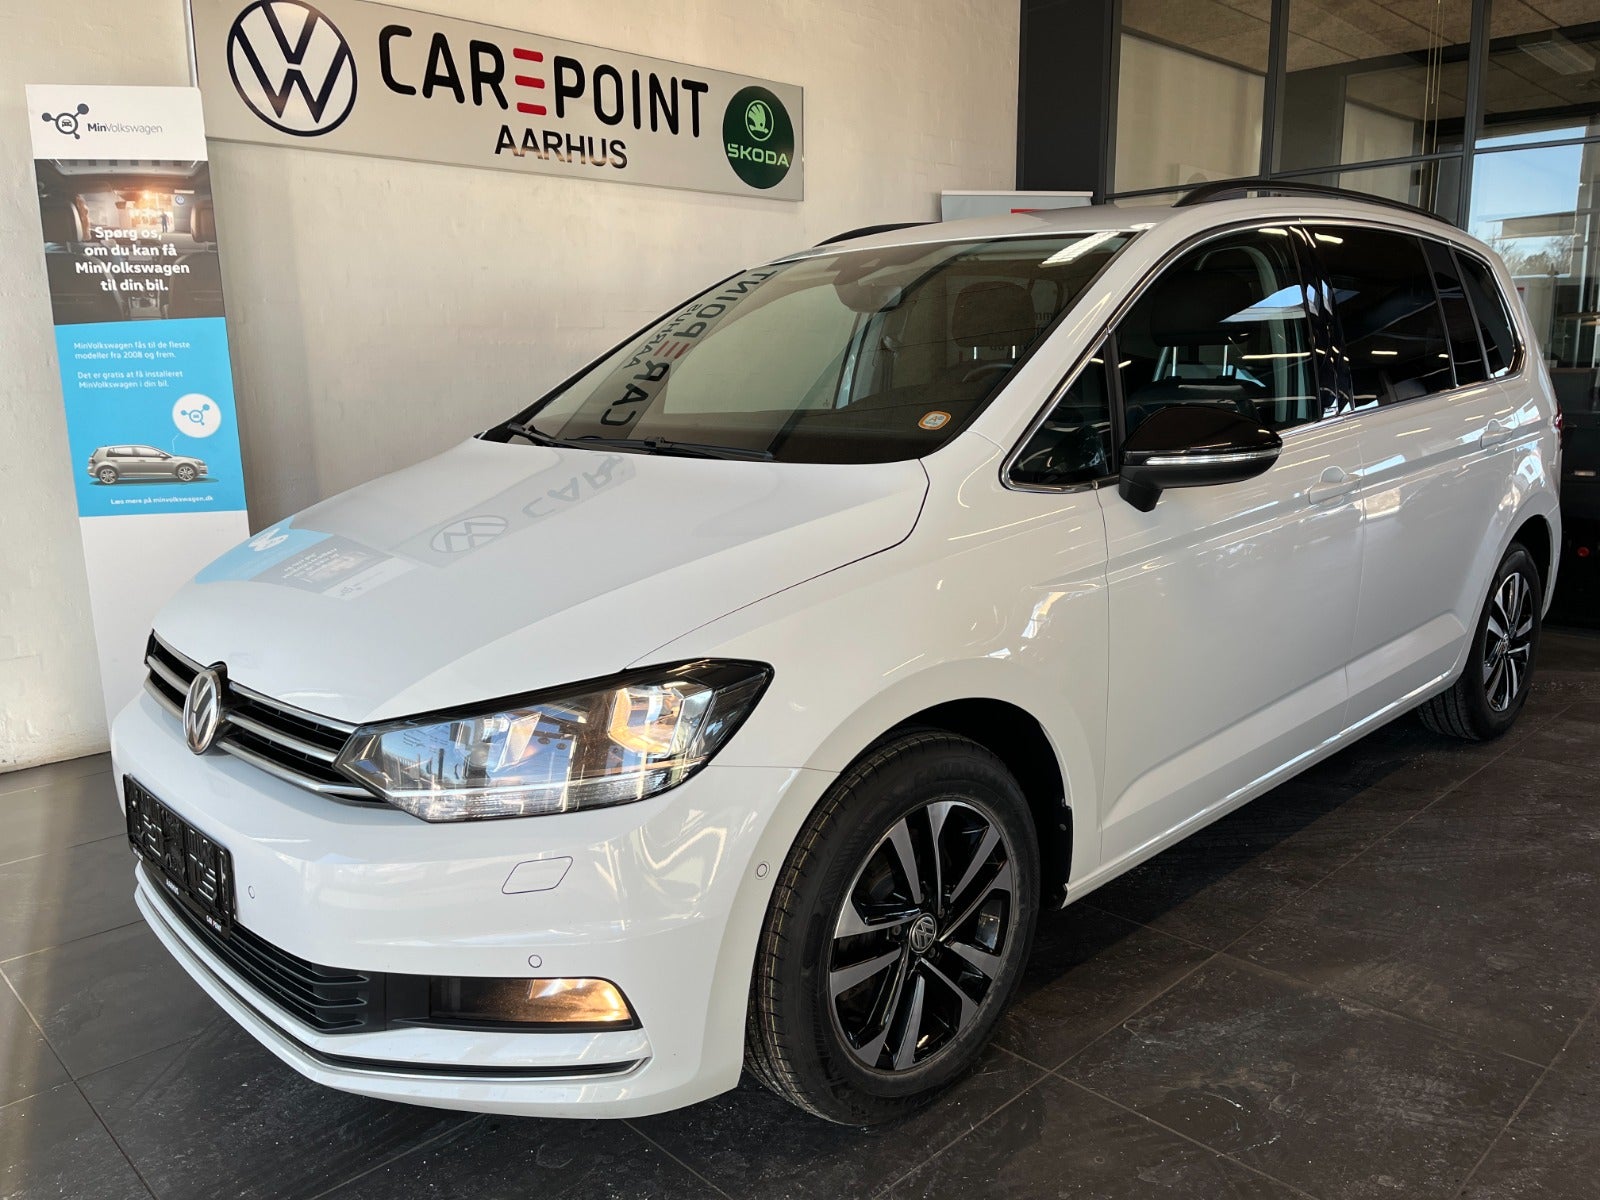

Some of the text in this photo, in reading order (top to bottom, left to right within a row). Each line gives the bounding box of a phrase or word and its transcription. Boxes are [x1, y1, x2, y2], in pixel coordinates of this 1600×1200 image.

[379, 24, 709, 138] CAREPOINT
[87, 122, 163, 134] MinVolkswagen
[494, 124, 629, 169] AARHUS
[95, 226, 162, 241] Spørg os,
[84, 243, 177, 256] om du kan få
[75, 261, 190, 276] MinVolkswagen
[100, 279, 169, 291] til din bil.
[74, 340, 191, 351] MinVolkswagen fås til de fleste
[75, 351, 176, 360] modeller fra 2008 og frem.
[77, 371, 91, 379] Det
[102, 371, 125, 380] gratis
[135, 370, 144, 378] få
[145, 370, 184, 378] installeret
[78, 381, 138, 390] MinVolkswagen
[143, 380, 156, 388] din
